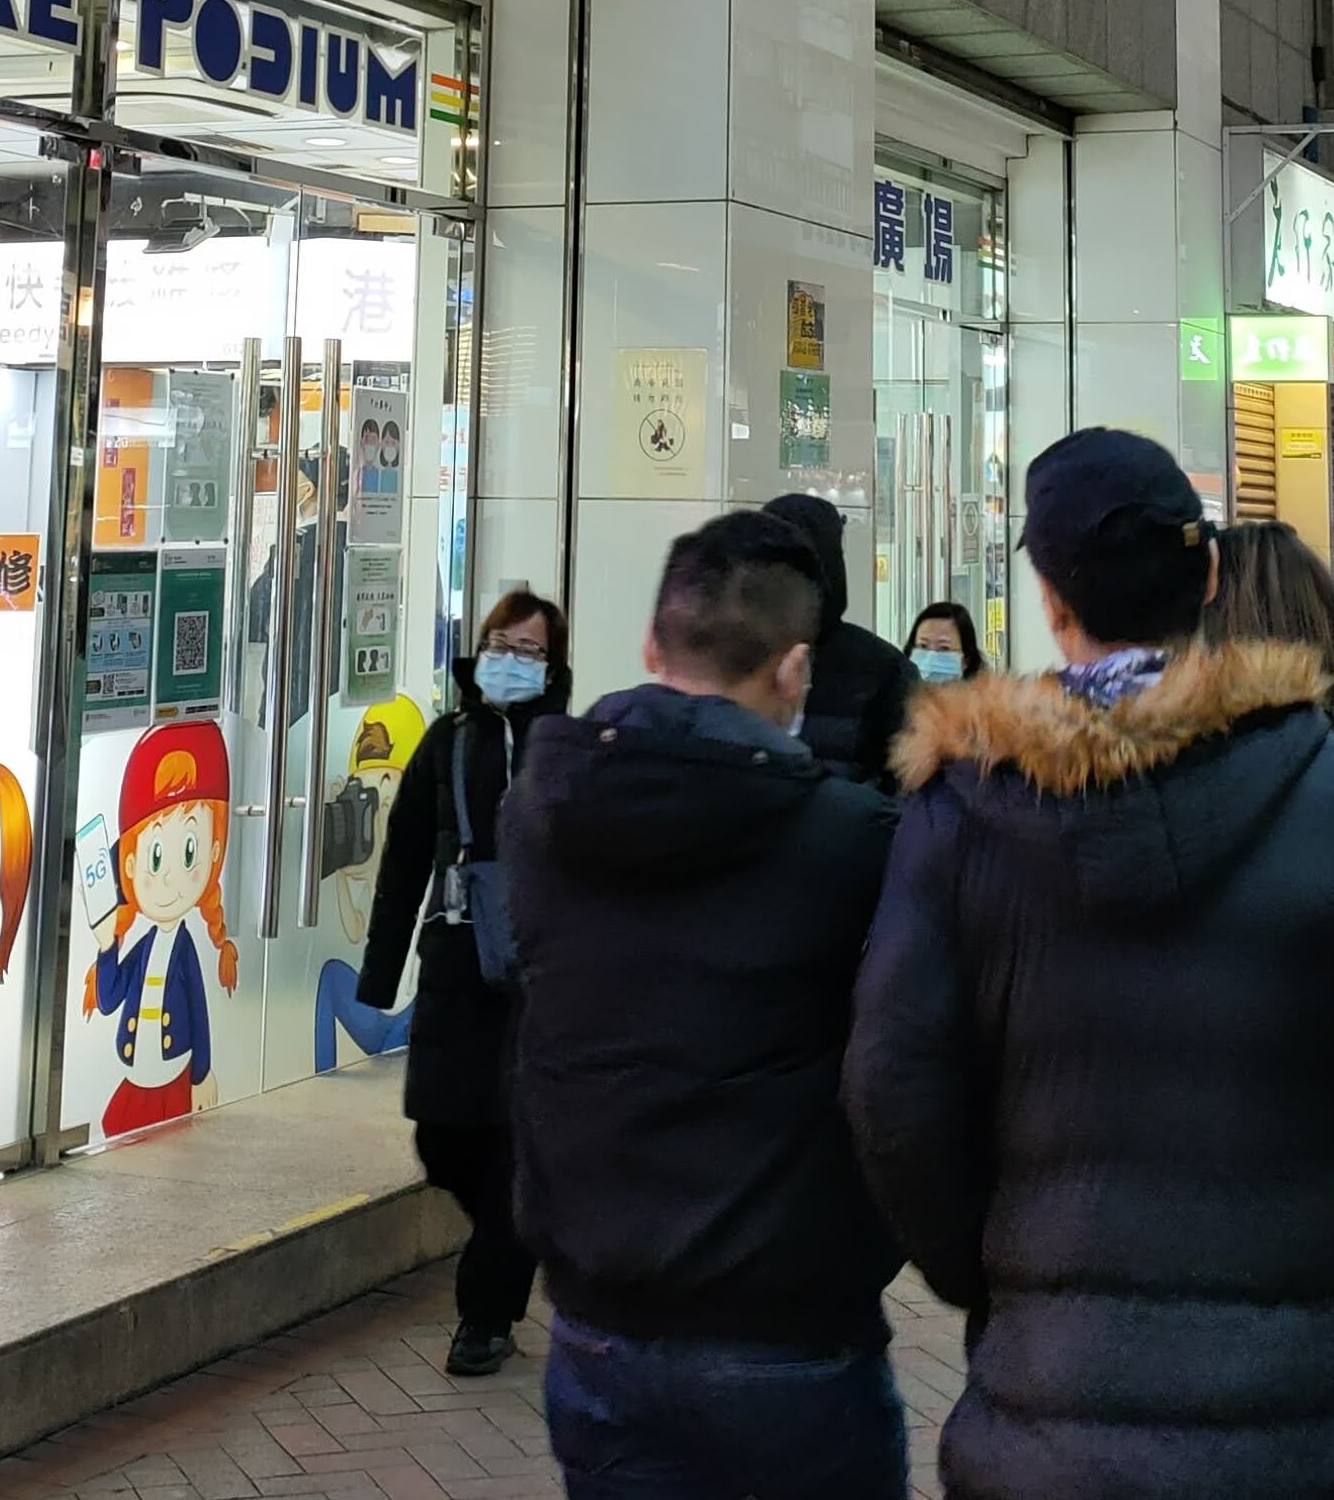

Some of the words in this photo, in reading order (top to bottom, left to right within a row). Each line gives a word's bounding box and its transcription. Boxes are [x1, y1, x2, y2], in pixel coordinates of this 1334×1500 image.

[874, 179, 954, 285] 廣場
[342, 267, 397, 333] 港
[84, 862, 109, 890] 5G
